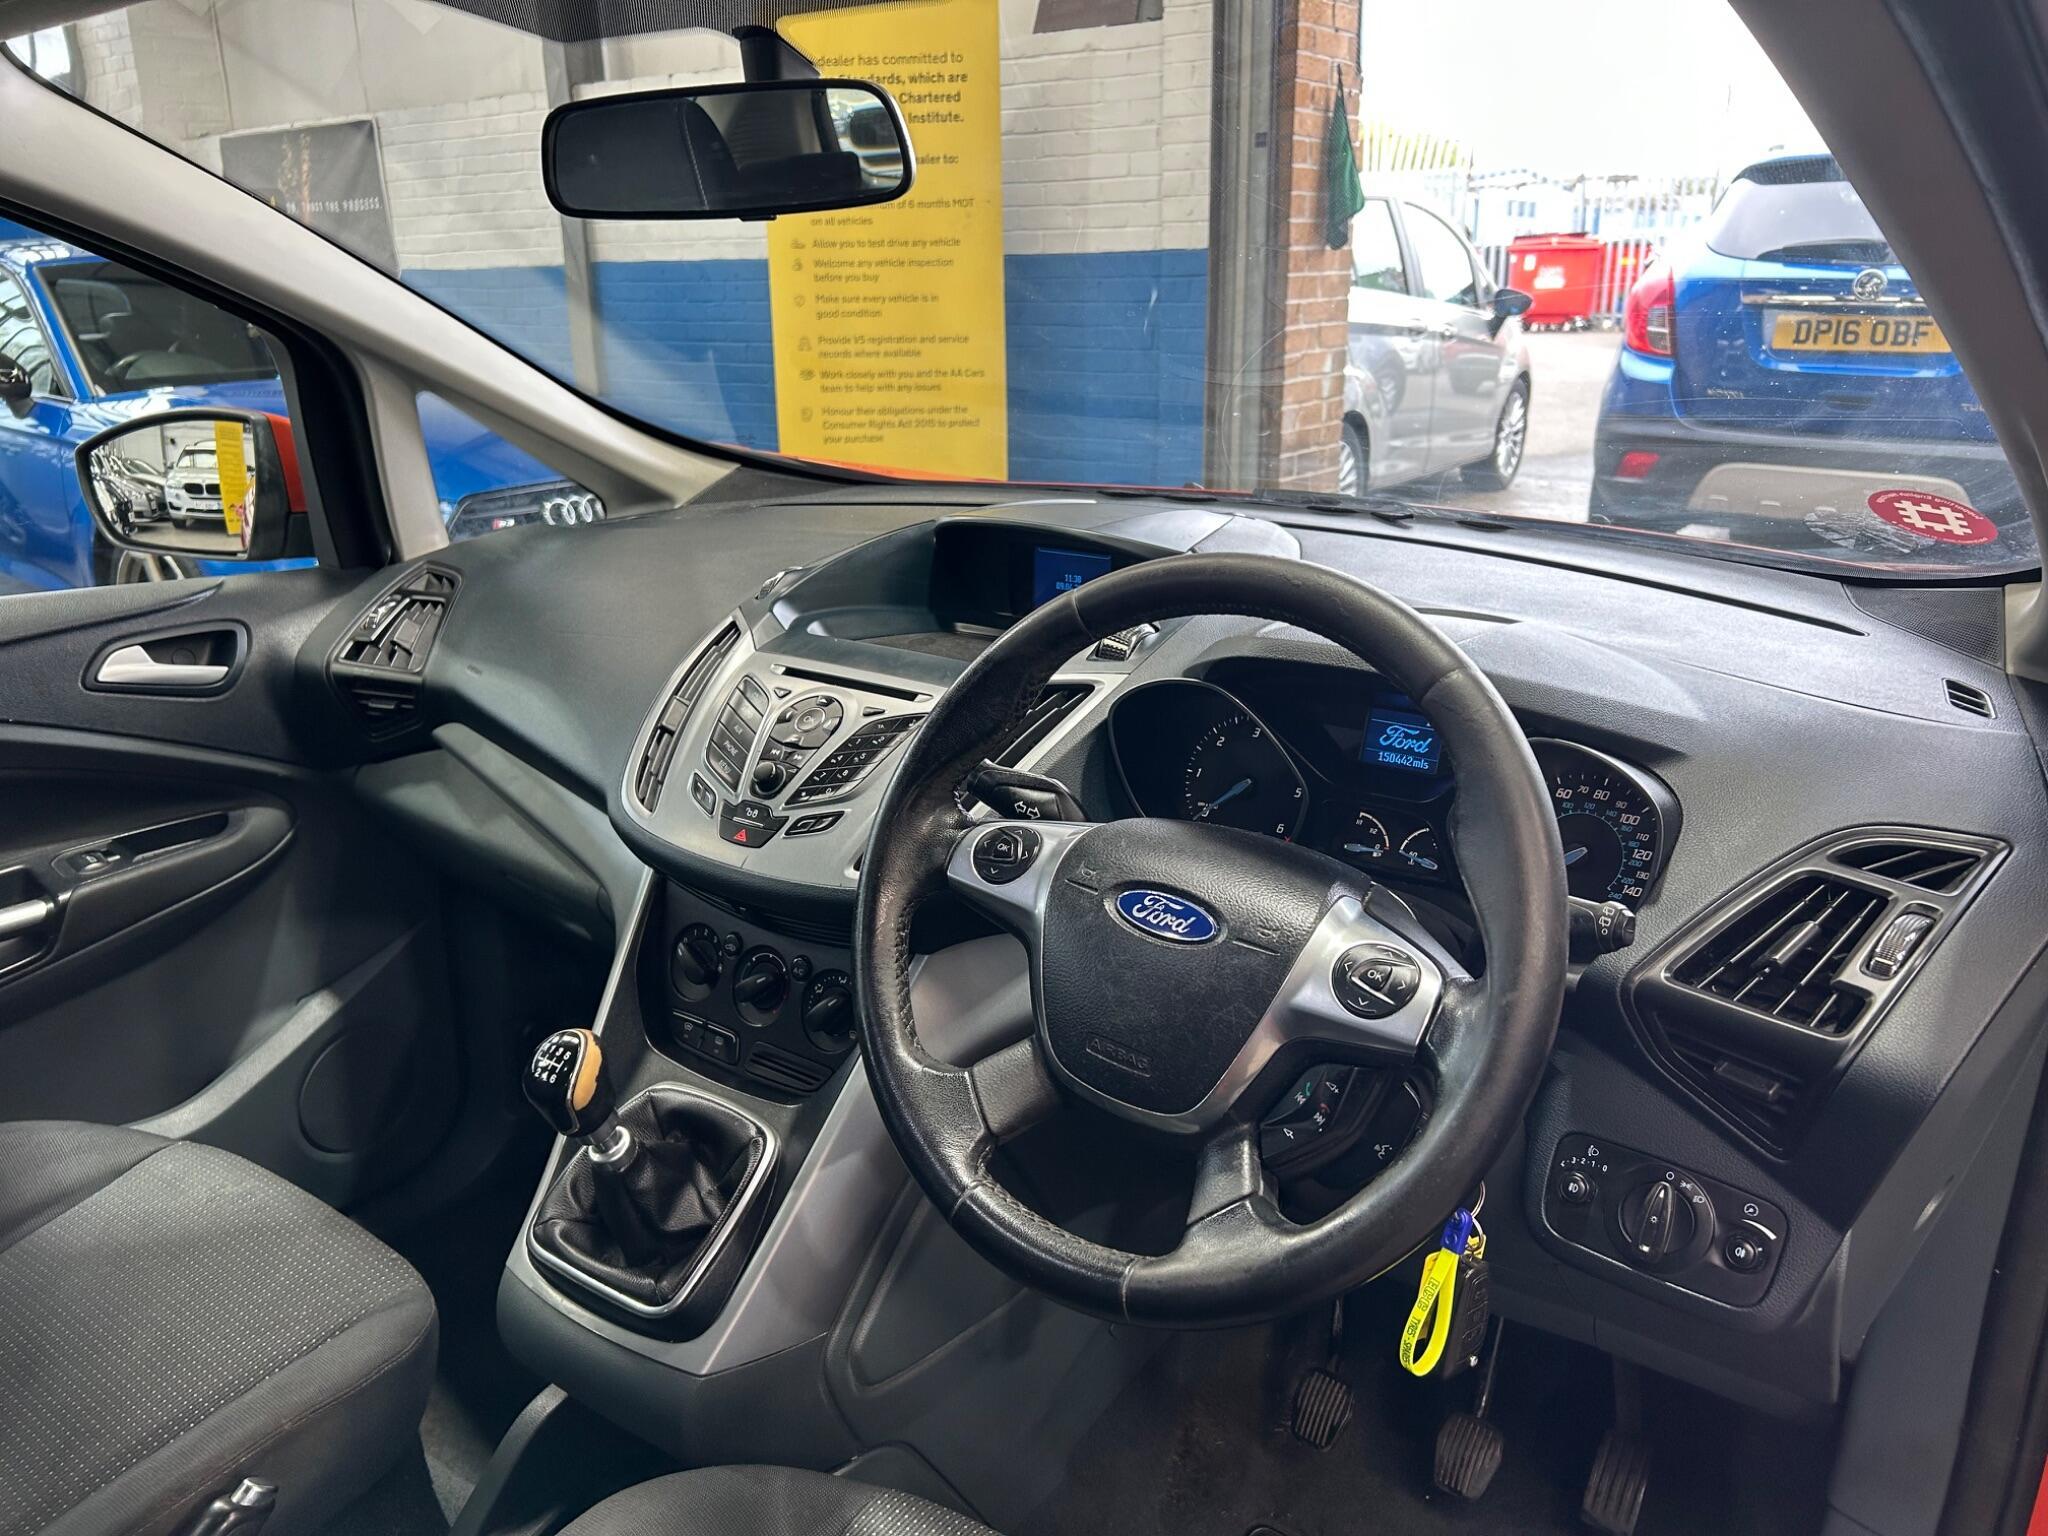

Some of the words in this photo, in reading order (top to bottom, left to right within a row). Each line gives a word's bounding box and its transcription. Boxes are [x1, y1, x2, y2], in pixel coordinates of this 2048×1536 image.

[818, 54, 854, 66] dealer
[858, 54, 880, 65] has
[882, 53, 947, 65] committed
[951, 53, 963, 63] to
[908, 73, 944, 84] which
[948, 73, 968, 83] are
[899, 92, 961, 104] Chartered
[908, 113, 965, 124] Institute.
[812, 238, 837, 248] Allow
[838, 240, 855, 250] you
[1793, 319, 1861, 345] DP16
[1870, 319, 1934, 346] OBF
[1252, 727, 1261, 739] 3
[1379, 725, 1432, 753] Ford
[1216, 736, 1225, 748] 2
[1196, 767, 1202, 779] 1
[1294, 787, 1302, 799] 5
[1555, 788, 1573, 799] 60
[1576, 785, 1590, 794] 70
[1593, 789, 1611, 801] 80
[1615, 800, 1628, 809] 90
[1619, 813, 1641, 826] 100
[1276, 823, 1285, 835] 6
[1636, 832, 1650, 841] 110
[997, 842, 1011, 853] OK
[1632, 849, 1653, 861] 120
[1636, 871, 1650, 880] 130
[1607, 892, 1623, 900] 240
[1622, 884, 1643, 897] 140
[1132, 895, 1197, 933] Ford
[1367, 968, 1385, 983] OK
[549, 1045, 556, 1053] 1
[555, 1047, 564, 1056] 3
[534, 1068, 541, 1077] 2
[541, 1071, 549, 1081] 4
[549, 1074, 556, 1083] 6
